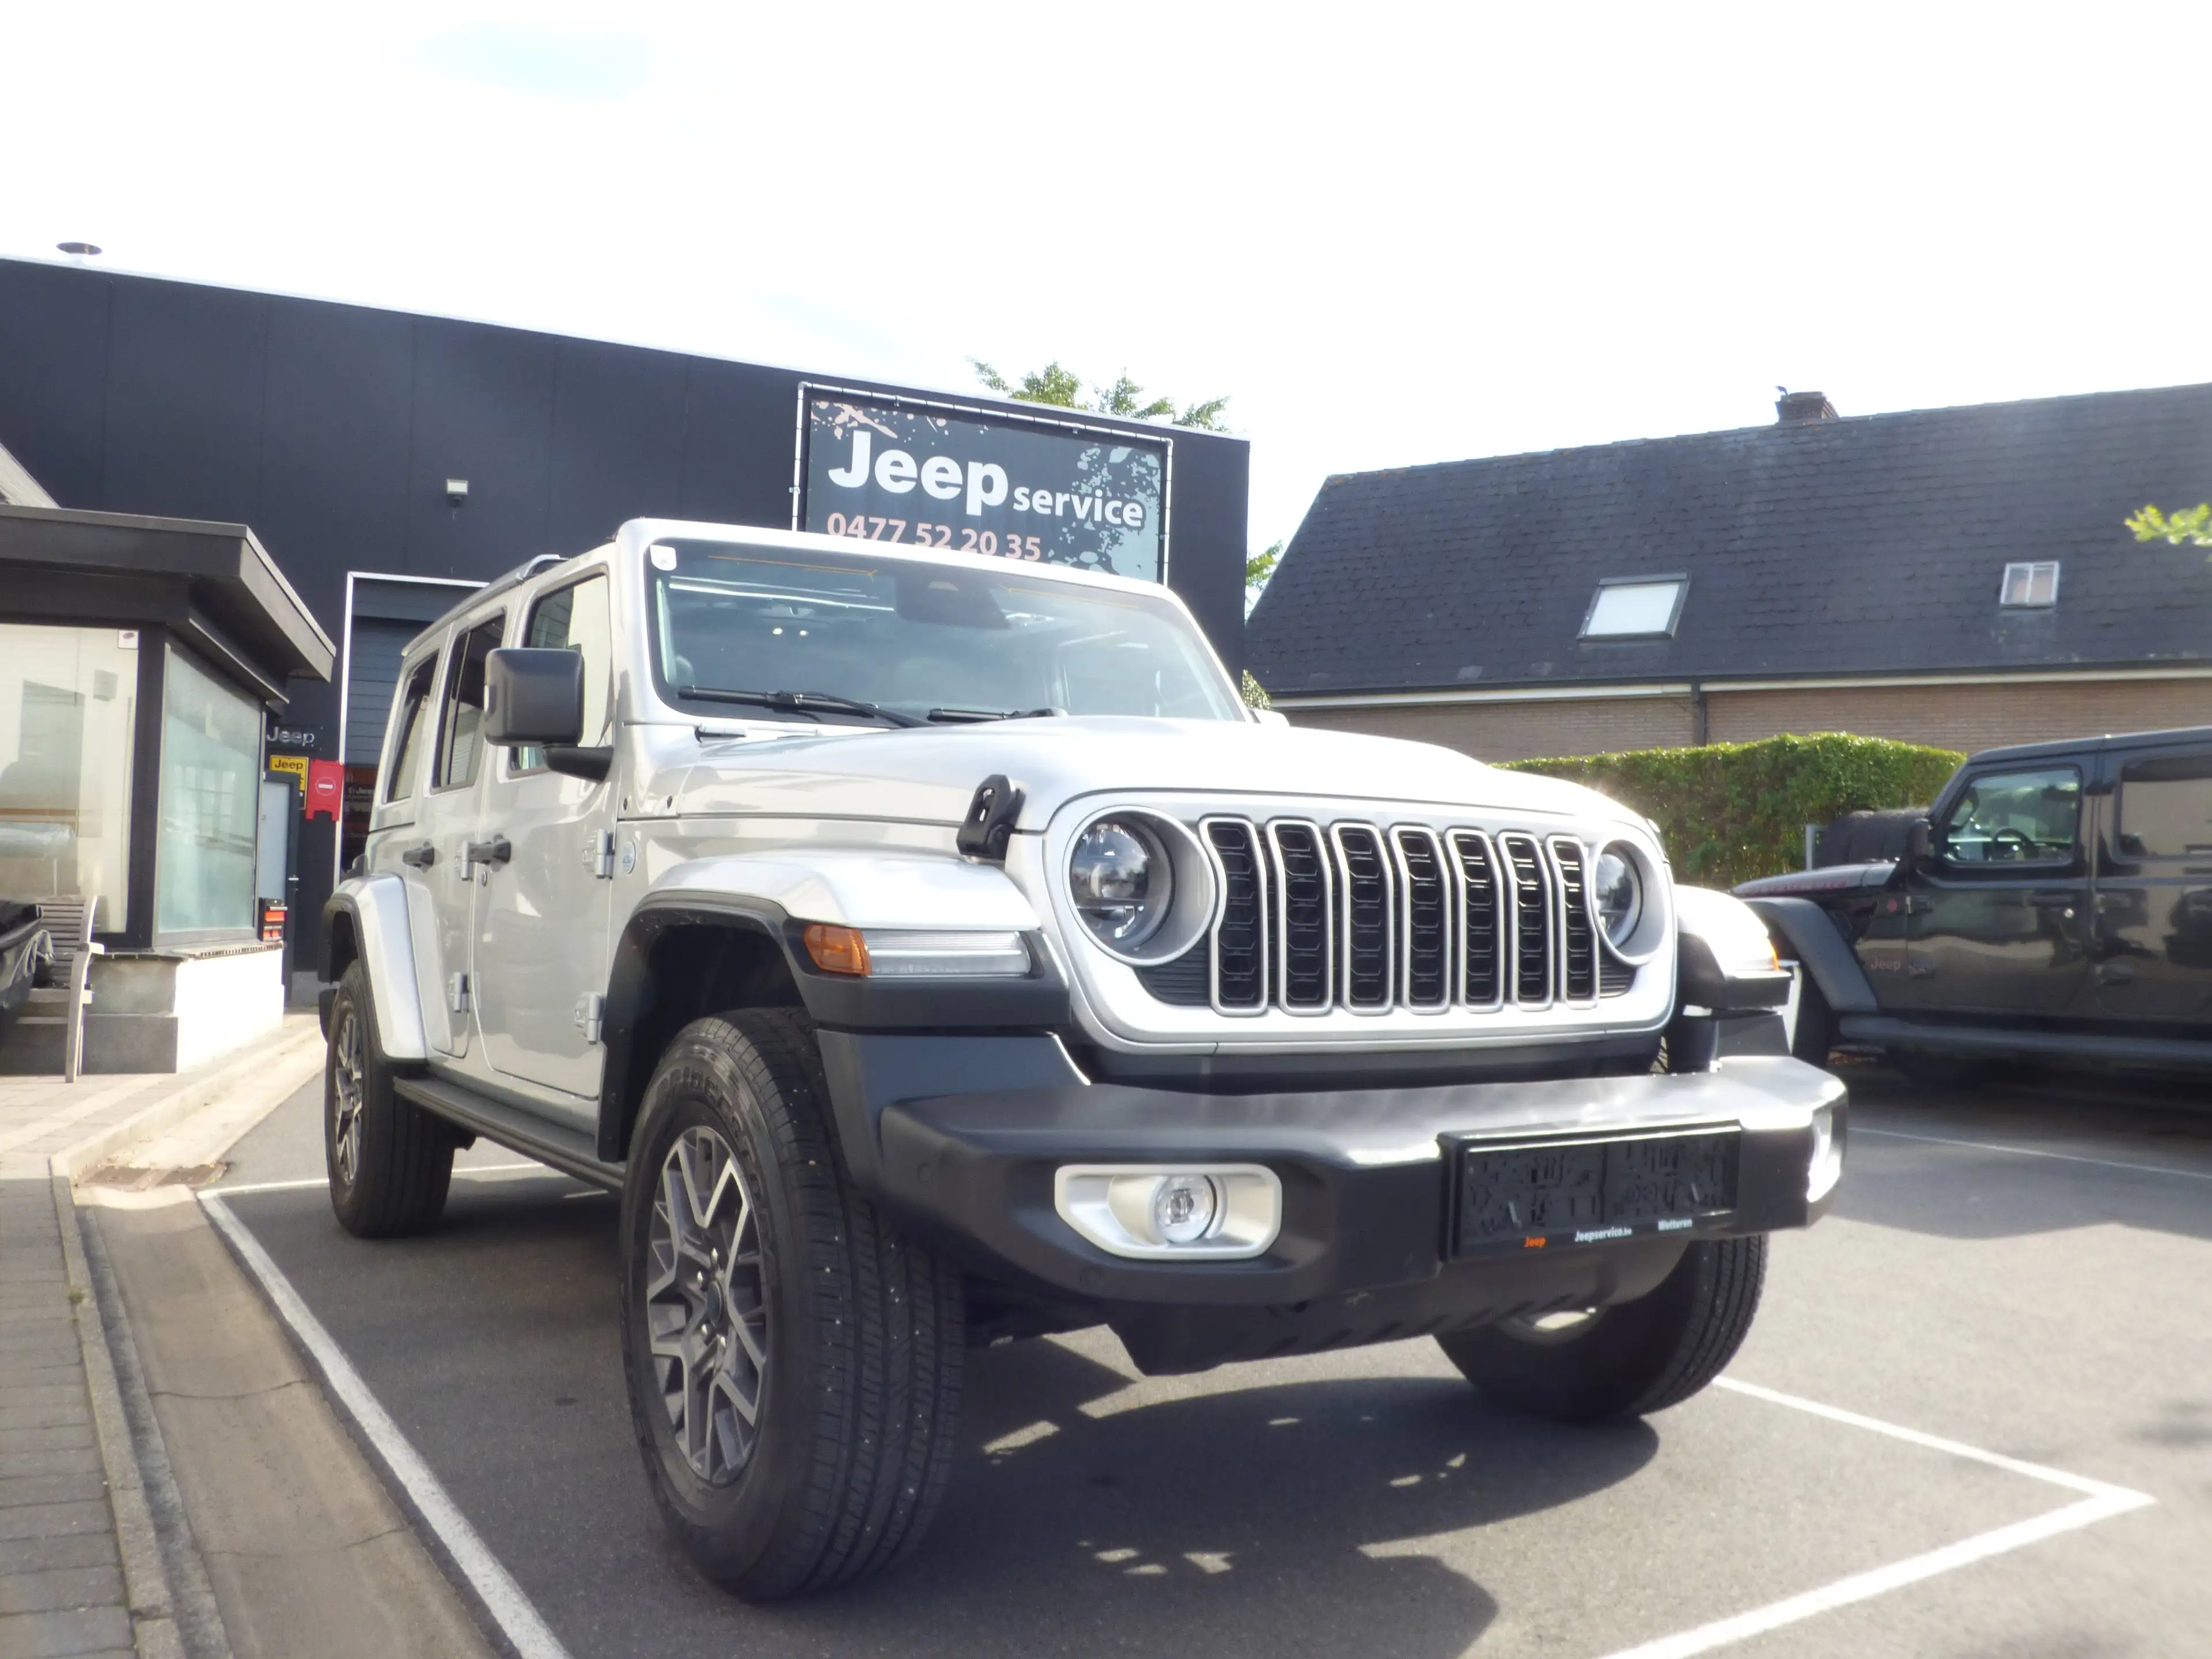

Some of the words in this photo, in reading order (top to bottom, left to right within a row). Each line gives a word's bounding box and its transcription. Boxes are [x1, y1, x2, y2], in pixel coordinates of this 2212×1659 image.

[828, 430, 1008, 516] Jeep
[1013, 486, 1143, 527] service
[827, 512, 906, 543] 0477
[915, 522, 951, 549] 52
[960, 528, 998, 556] 20
[1005, 533, 1040, 561] 35
[266, 726, 315, 747] Jeep
[275, 759, 303, 770] Jeep
